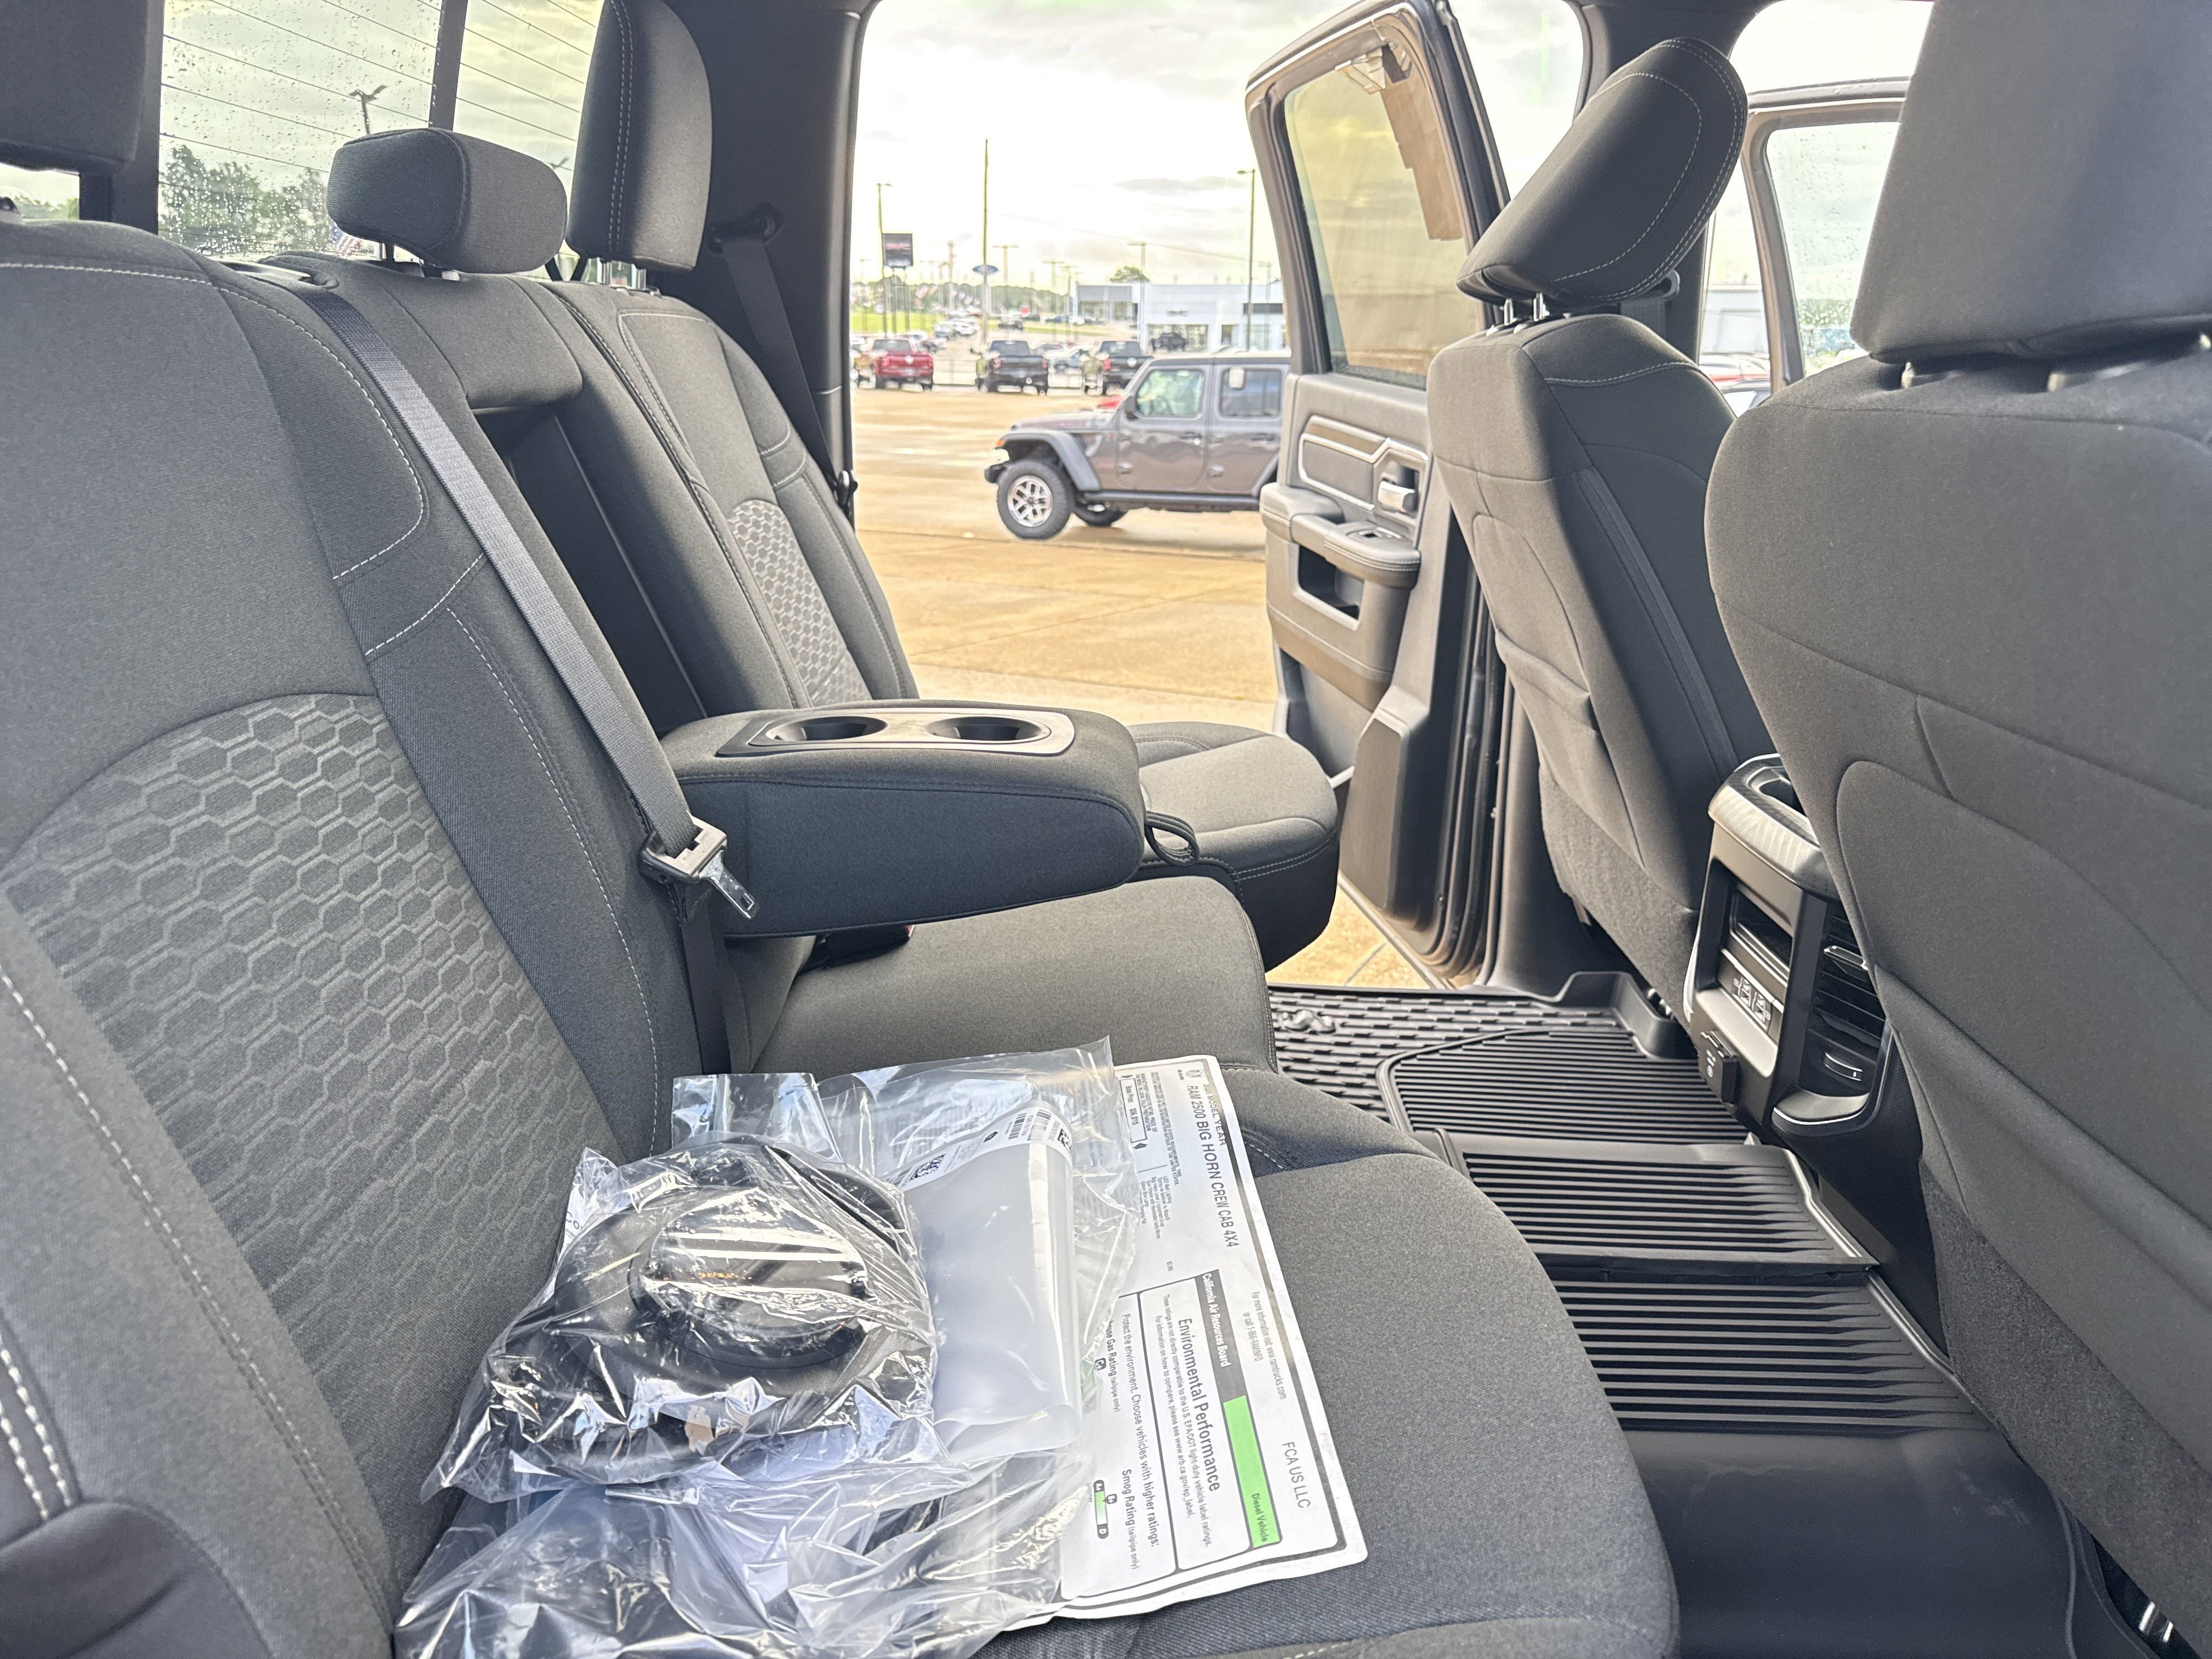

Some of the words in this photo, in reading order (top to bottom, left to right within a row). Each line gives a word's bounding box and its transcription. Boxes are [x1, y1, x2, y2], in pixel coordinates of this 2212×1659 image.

[1187, 1086, 1201, 1099] RAM
[1191, 1101, 1206, 1119] 2500
[1207, 1096, 1218, 1118] MODEL
[1215, 1120, 1226, 1146] YEAR
[1197, 1121, 1212, 1140] BIG
[1201, 1144, 1222, 1179] HORN
[1211, 1182, 1229, 1207] CREW
[1218, 1210, 1234, 1228] CAB
[1223, 1231, 1239, 1247] 4X4
[1203, 1273, 1217, 1304] California
[1209, 1304, 1219, 1313] Air
[1254, 1300, 1262, 1311] more
[1122, 1313, 1131, 1334] Protect
[1211, 1313, 1224, 1345] Resources
[1244, 1318, 1254, 1326] call
[1257, 1311, 1269, 1336] information
[1107, 1339, 1116, 1352] Gas
[1124, 1334, 1132, 1345] the
[1156, 1323, 1165, 1349] information
[1170, 1338, 1178, 1355] directly
[1108, 1352, 1118, 1376] Rating
[1160, 1350, 1167, 1358] on
[1217, 1345, 1232, 1367] Board
[1125, 1346, 1138, 1393] environment.
[1172, 1355, 1184, 1388] comparable
[1267, 1347, 1286, 1400] www.ramtrucks.com
[1110, 1376, 1119, 1397] (tailpipe
[1165, 1378, 1174, 1404] compare,
[1113, 1398, 1121, 1412] only)
[1131, 1394, 1142, 1425] Choose
[1167, 1406, 1178, 1425] please
[1178, 1318, 1207, 1401] Environmental
[1194, 1402, 1220, 1491] Performance
[1136, 1426, 1148, 1460] vehicles
[1282, 1442, 1299, 1465] FCA
[1141, 1460, 1152, 1481] with
[1188, 1448, 1200, 1479] light-duty
[1289, 1466, 1304, 1483] US
[1121, 1469, 1132, 1494] Smog
[1195, 1480, 1205, 1503] vehicle
[1142, 1481, 1155, 1510] higher
[1251, 1493, 1264, 1515] Diesel
[1294, 1485, 1311, 1508] LLC
[1125, 1496, 1137, 1526] Rating
[1199, 1503, 1209, 1521] label
[1127, 1527, 1137, 1552] (tailpipe
[1147, 1513, 1159, 1547] ratings:
[1257, 1515, 1269, 1542] Vehicle
[1131, 1553, 1140, 1570] only)
